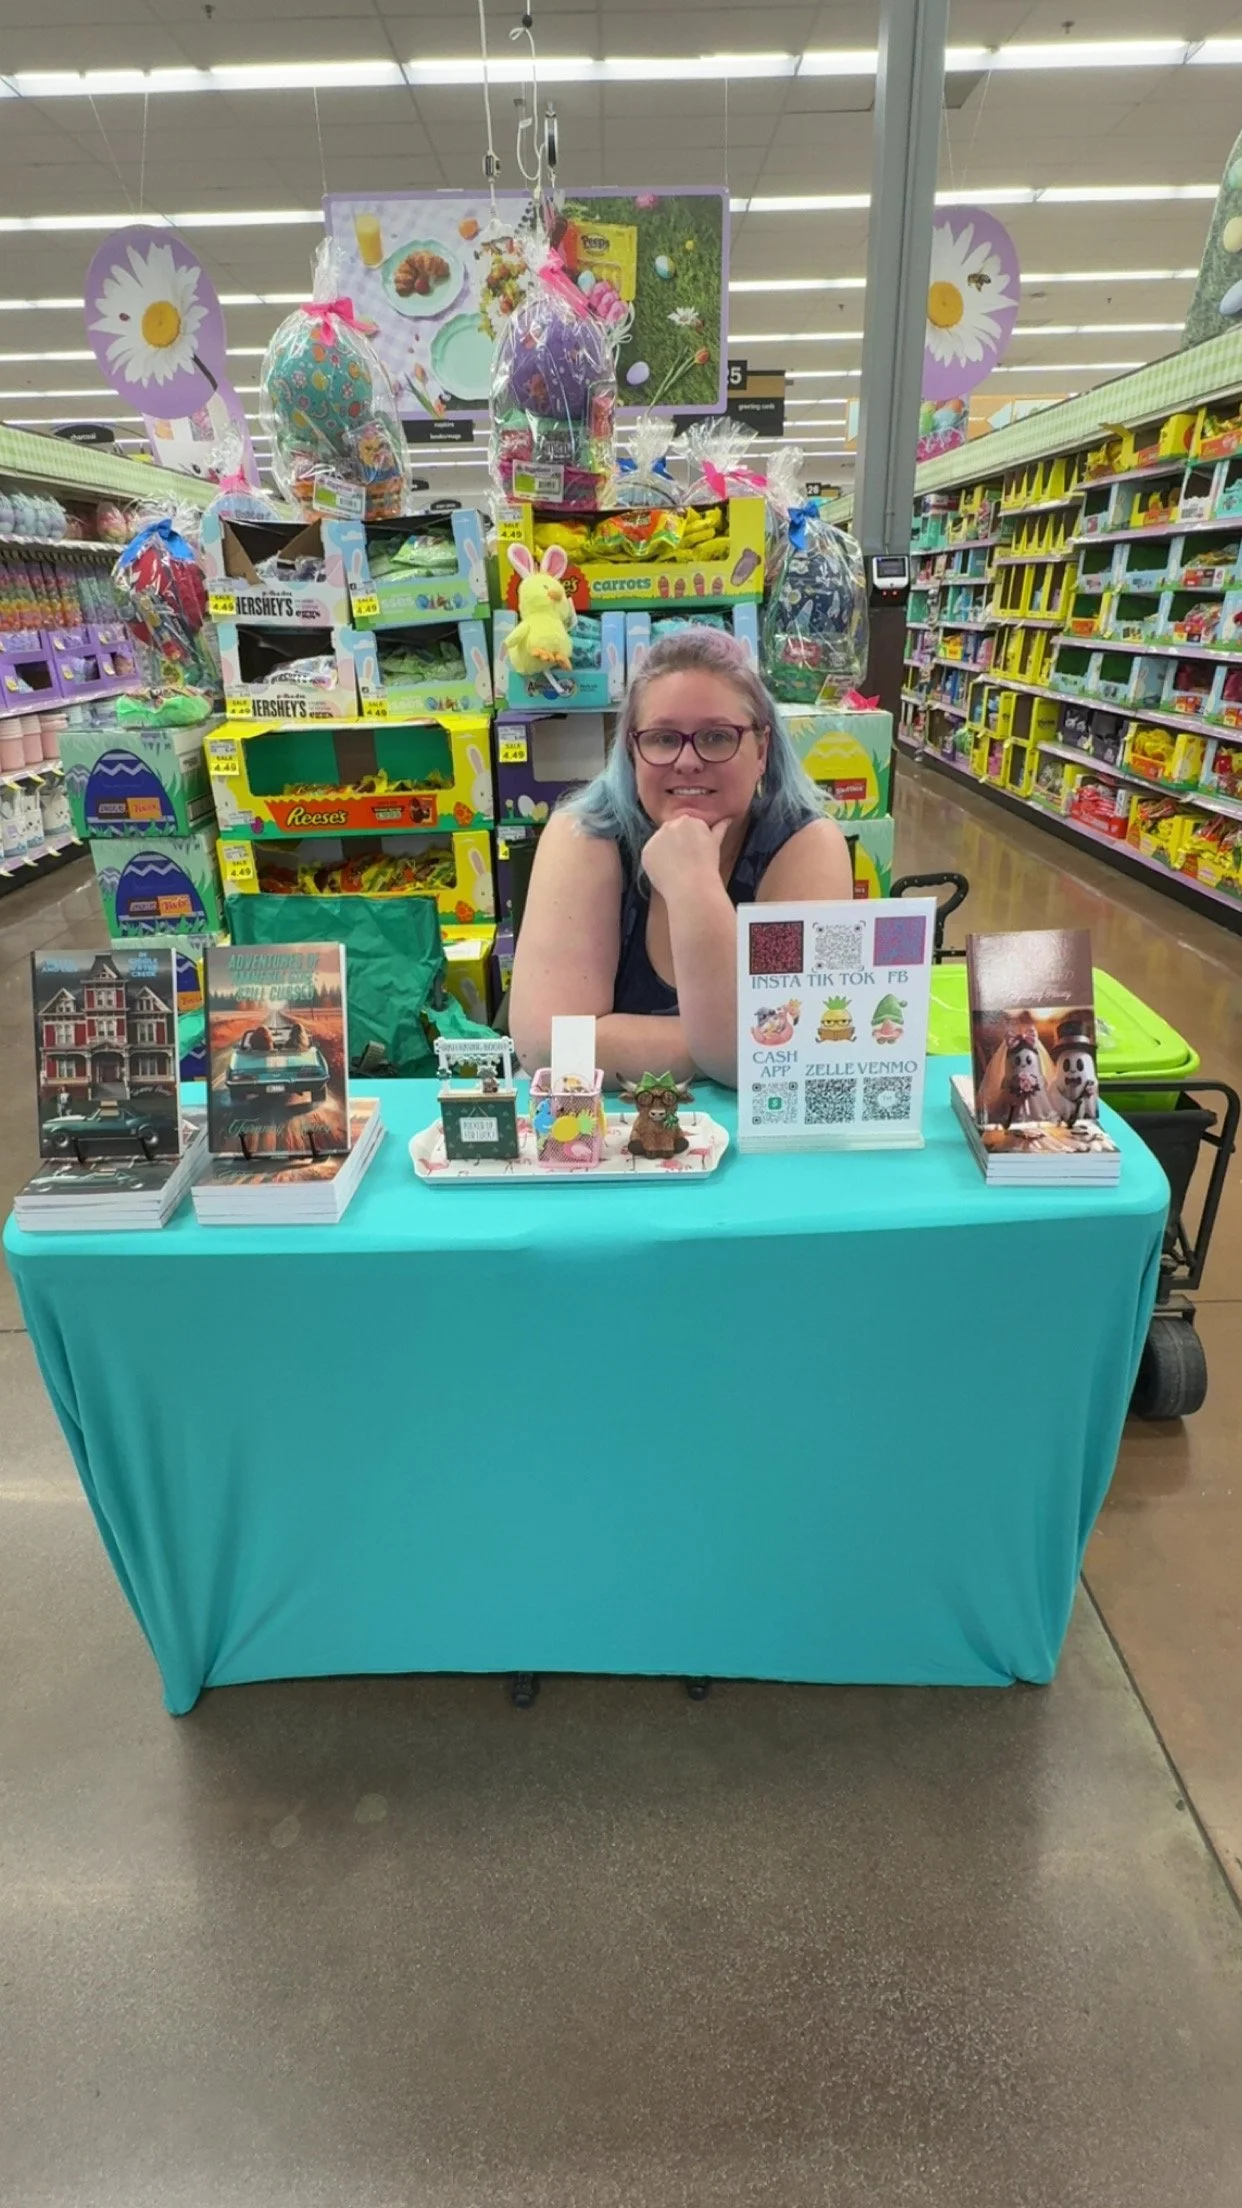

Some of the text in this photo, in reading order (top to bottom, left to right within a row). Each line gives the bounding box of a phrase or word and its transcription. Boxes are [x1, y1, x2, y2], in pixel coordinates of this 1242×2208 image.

[501, 530, 522, 539] 4.49
[592, 577, 652, 593] carrots
[212, 603, 235, 611] 4.49
[356, 605, 378, 614] 4.49
[503, 750, 526, 759] 4.49
[214, 763, 237, 772] 4.49
[287, 806, 348, 826] Reese's
[230, 867, 252, 877] 4.49
[751, 971, 909, 990] INSTA TIK TOK FB
[752, 1050, 799, 1064] CASH
[760, 1065, 791, 1078] APP
[805, 1060, 918, 1077] ZELLE VENMO
